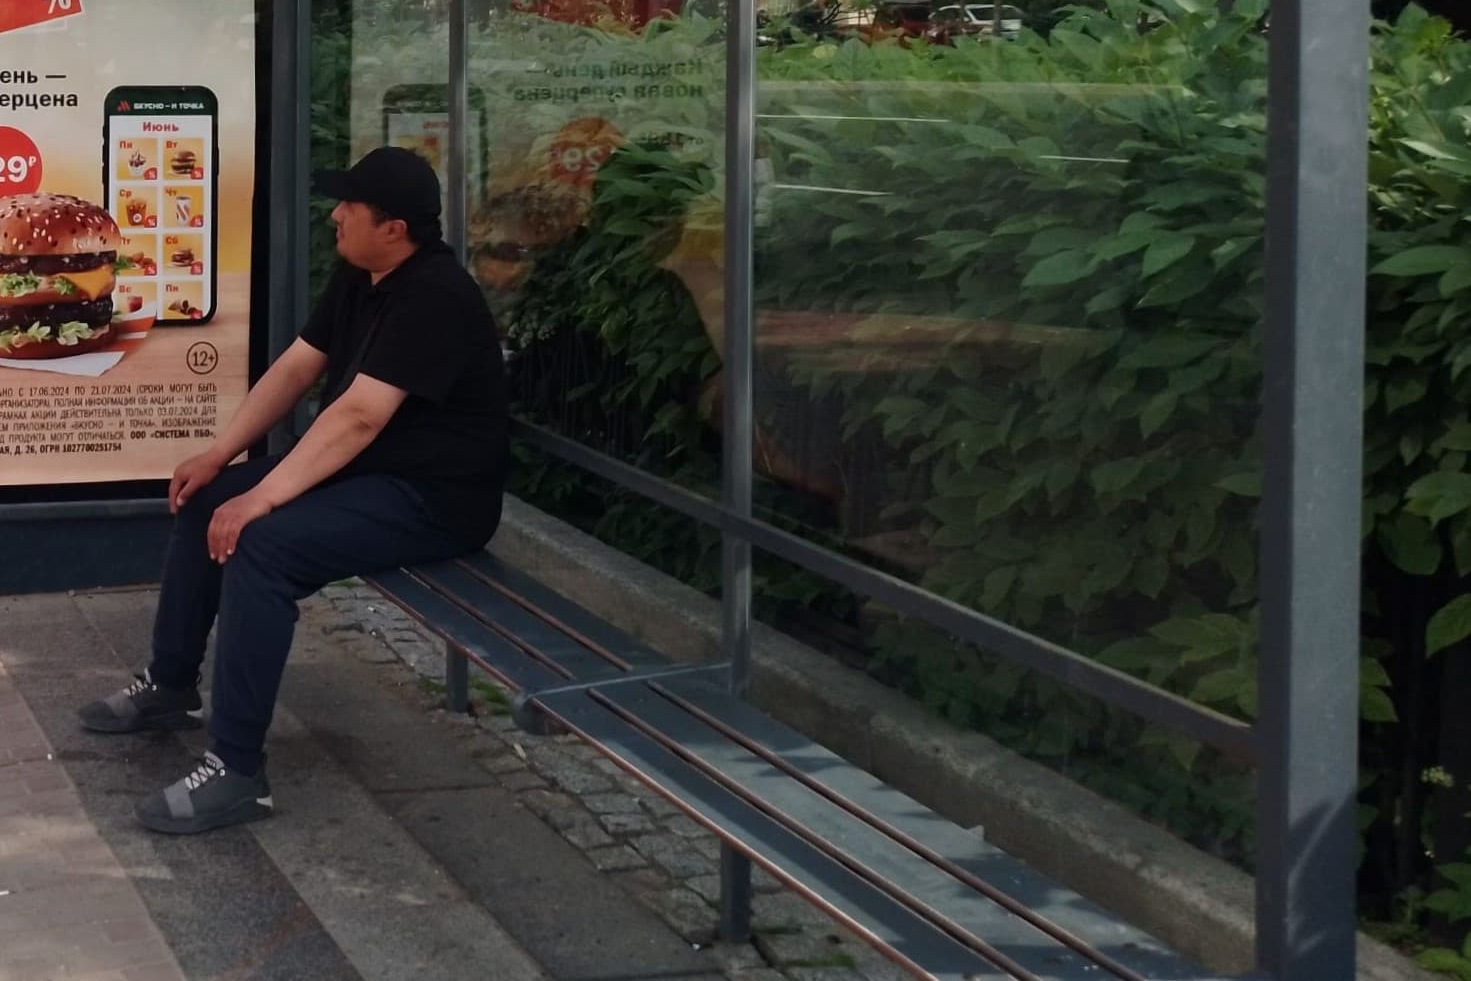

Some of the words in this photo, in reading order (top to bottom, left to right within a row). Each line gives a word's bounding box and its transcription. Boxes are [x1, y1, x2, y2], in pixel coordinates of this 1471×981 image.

[133, 102, 164, 110] ВКУСНО
[179, 102, 204, 110] ТОЧКА
[143, 122, 179, 132] Июнь
[166, 140, 178, 149] Вт
[119, 189, 132, 197] Ср
[192, 352, 215, 367] 12+
[18, 387, 24, 397] С
[29, 387, 69, 397] 17.06.2024
[75, 386, 85, 396] ПО
[169, 383, 192, 394] МОГУТ
[198, 382, 217, 393] БЫТЬ
[185, 394, 193, 403] НА
[125, 407, 153, 417] ТОЛЬКО
[9, 433, 46, 443] ПРОДУКТА
[51, 432, 74, 441] МОГУТ
[130, 431, 146, 439] ООО
[40, 444, 60, 454] ОГРН
[63, 443, 122, 453] 1027700251754
